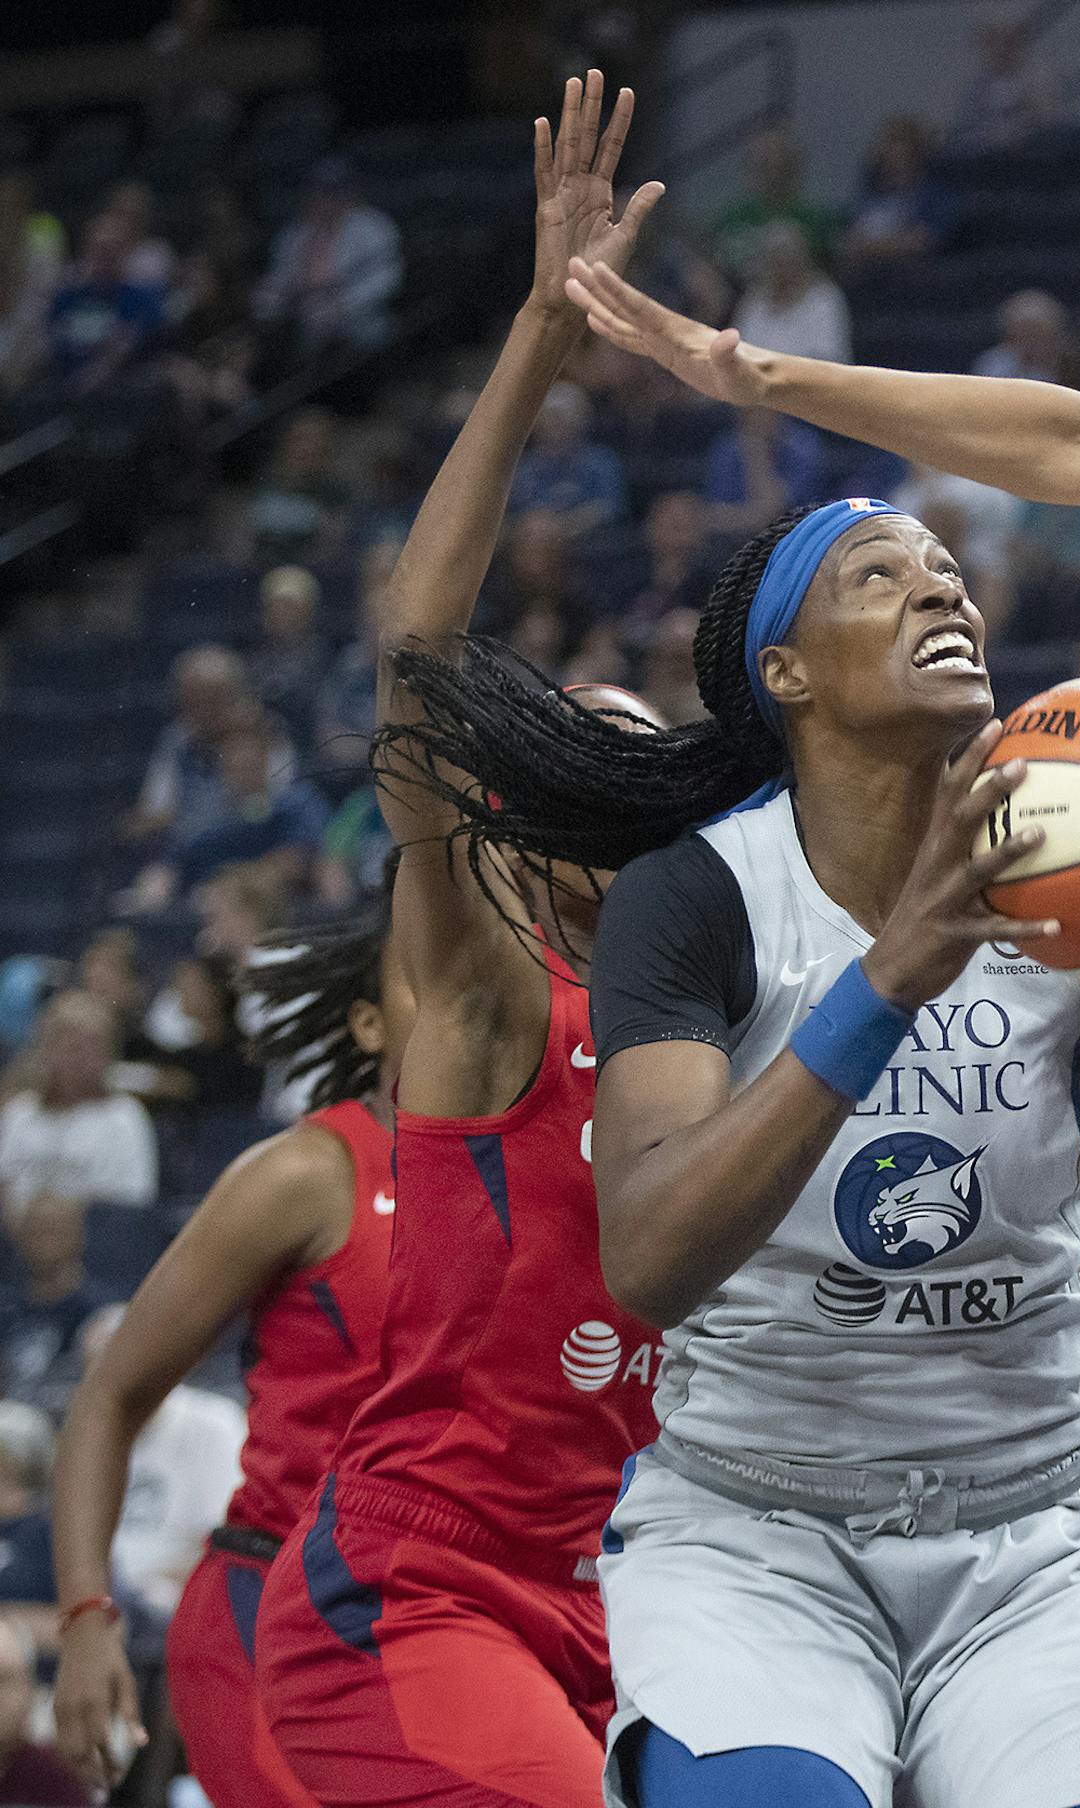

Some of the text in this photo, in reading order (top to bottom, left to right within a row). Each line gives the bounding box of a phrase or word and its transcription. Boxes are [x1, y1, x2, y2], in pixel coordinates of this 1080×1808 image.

[982, 962, 1050, 976] sharecare
[850, 1061, 1030, 1116] INIC
[895, 1275, 1024, 1327] AT&T
[621, 1343, 677, 1388] AT
